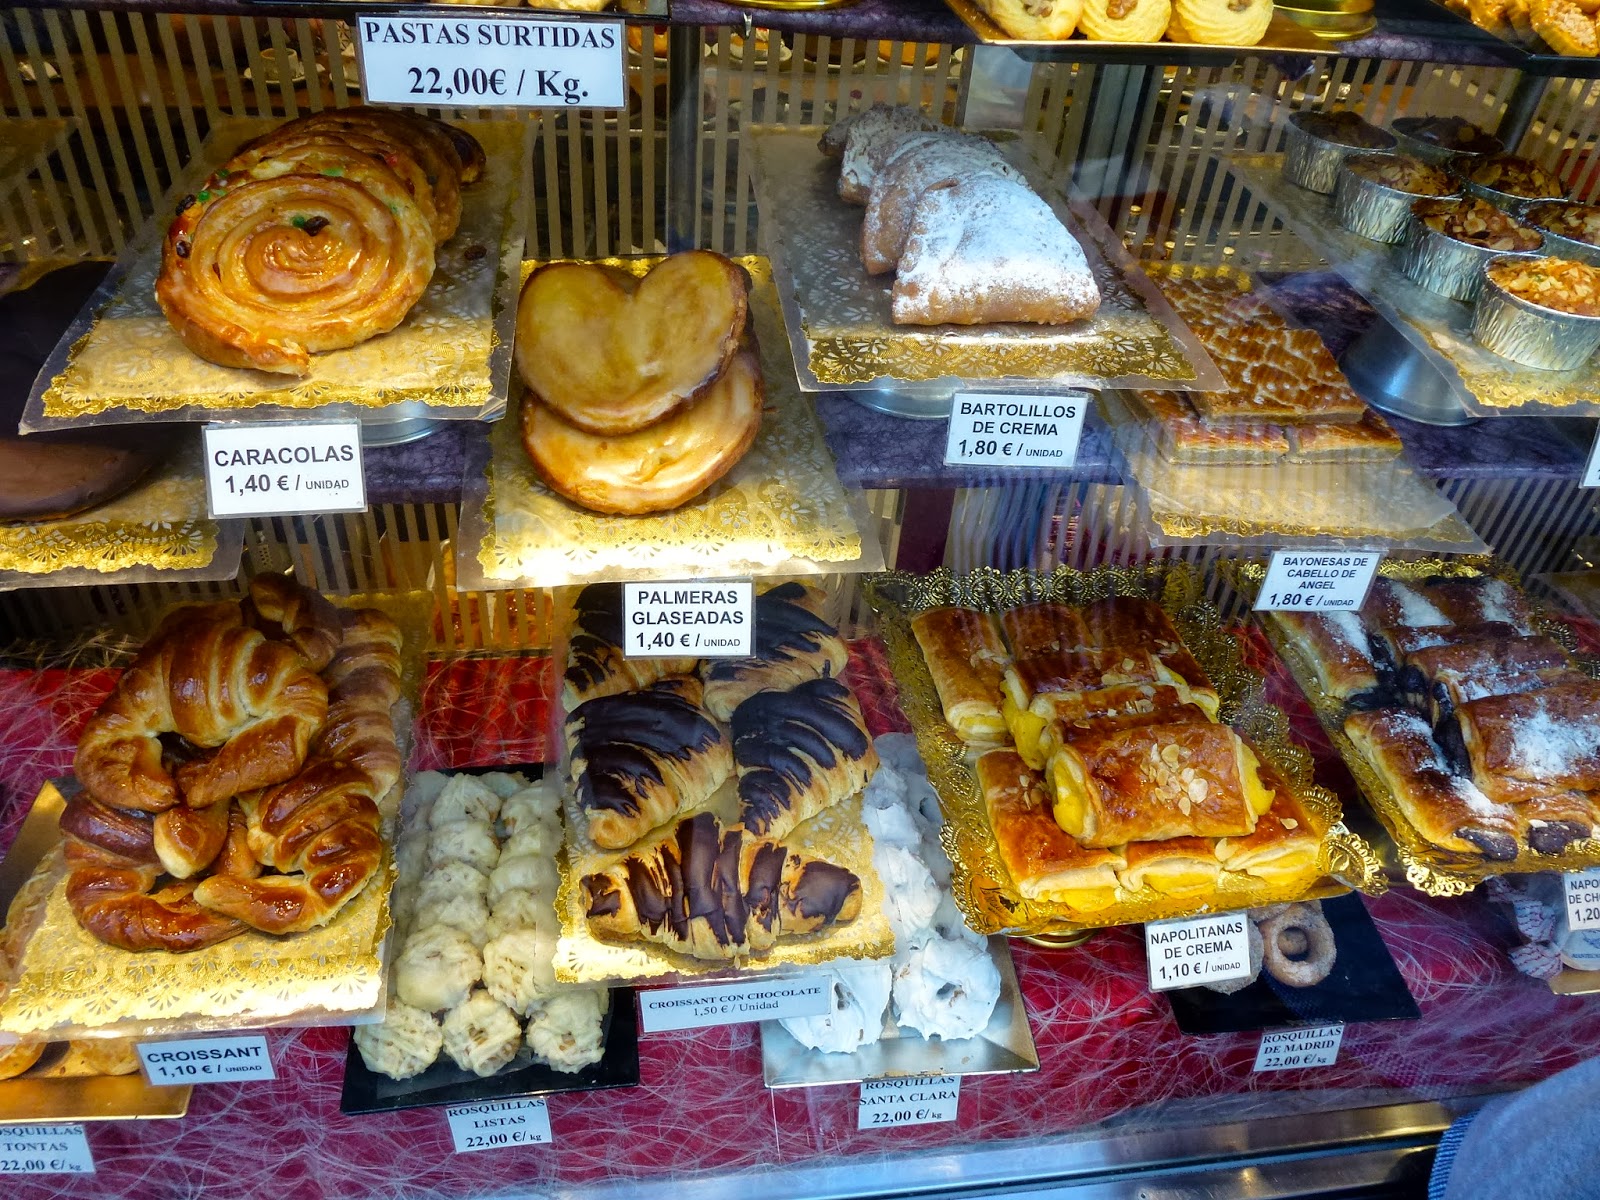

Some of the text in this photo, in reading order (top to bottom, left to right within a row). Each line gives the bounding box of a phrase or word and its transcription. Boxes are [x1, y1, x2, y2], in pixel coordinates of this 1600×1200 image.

[363, 21, 615, 48] PASTAS SURTIDAS
[407, 67, 589, 104] 22,00€ / Kg.
[960, 402, 1076, 418] BARTOLILLOS
[972, 422, 1058, 436] DE CREMA
[214, 445, 354, 466] CARACOLAS
[958, 440, 998, 457] 1,80
[1026, 449, 1063, 457] UNIDAD
[225, 474, 271, 496] 1,40
[306, 480, 349, 490] UNIDAD
[1283, 557, 1368, 566] BAYONESAS DE
[1287, 569, 1357, 578] CABELLO DE
[638, 590, 738, 604] PALMERAS
[1270, 594, 1301, 607] 1,80
[632, 611, 743, 624] GLASEADAS
[637, 632, 674, 650] 1,40
[1570, 880, 1600, 890] NAPO
[1569, 893, 1600, 904] DE CH
[1575, 907, 1600, 923] 1,20
[1151, 922, 1243, 945] NAPOLITANAS
[1164, 940, 1233, 959] DE CREMA
[1160, 963, 1189, 981] 1,10
[1212, 962, 1240, 972] UNIDAD
[649, 987, 821, 1009] CROISSANT CON CHOCOLATE
[693, 1001, 779, 1017] 1,50 € / Unidad
[1263, 1027, 1342, 1043] ROSQUILLAS
[148, 1046, 261, 1062] CROISSANT
[1264, 1040, 1334, 1054] DE MADRID
[1264, 1056, 1300, 1067] 22,00
[158, 1065, 196, 1078] 1,10
[866, 1076, 955, 1089] ROSQUILLAS
[860, 1091, 956, 1105] SANTA CLARA
[448, 1100, 545, 1117] ROSQUILLAS
[474, 1115, 525, 1128] LISTAS
[873, 1111, 911, 1123] 22,00
[3, 1143, 68, 1151] TONTAS
[466, 1134, 507, 1147] 22,00
[1, 1160, 45, 1172] 22,00
